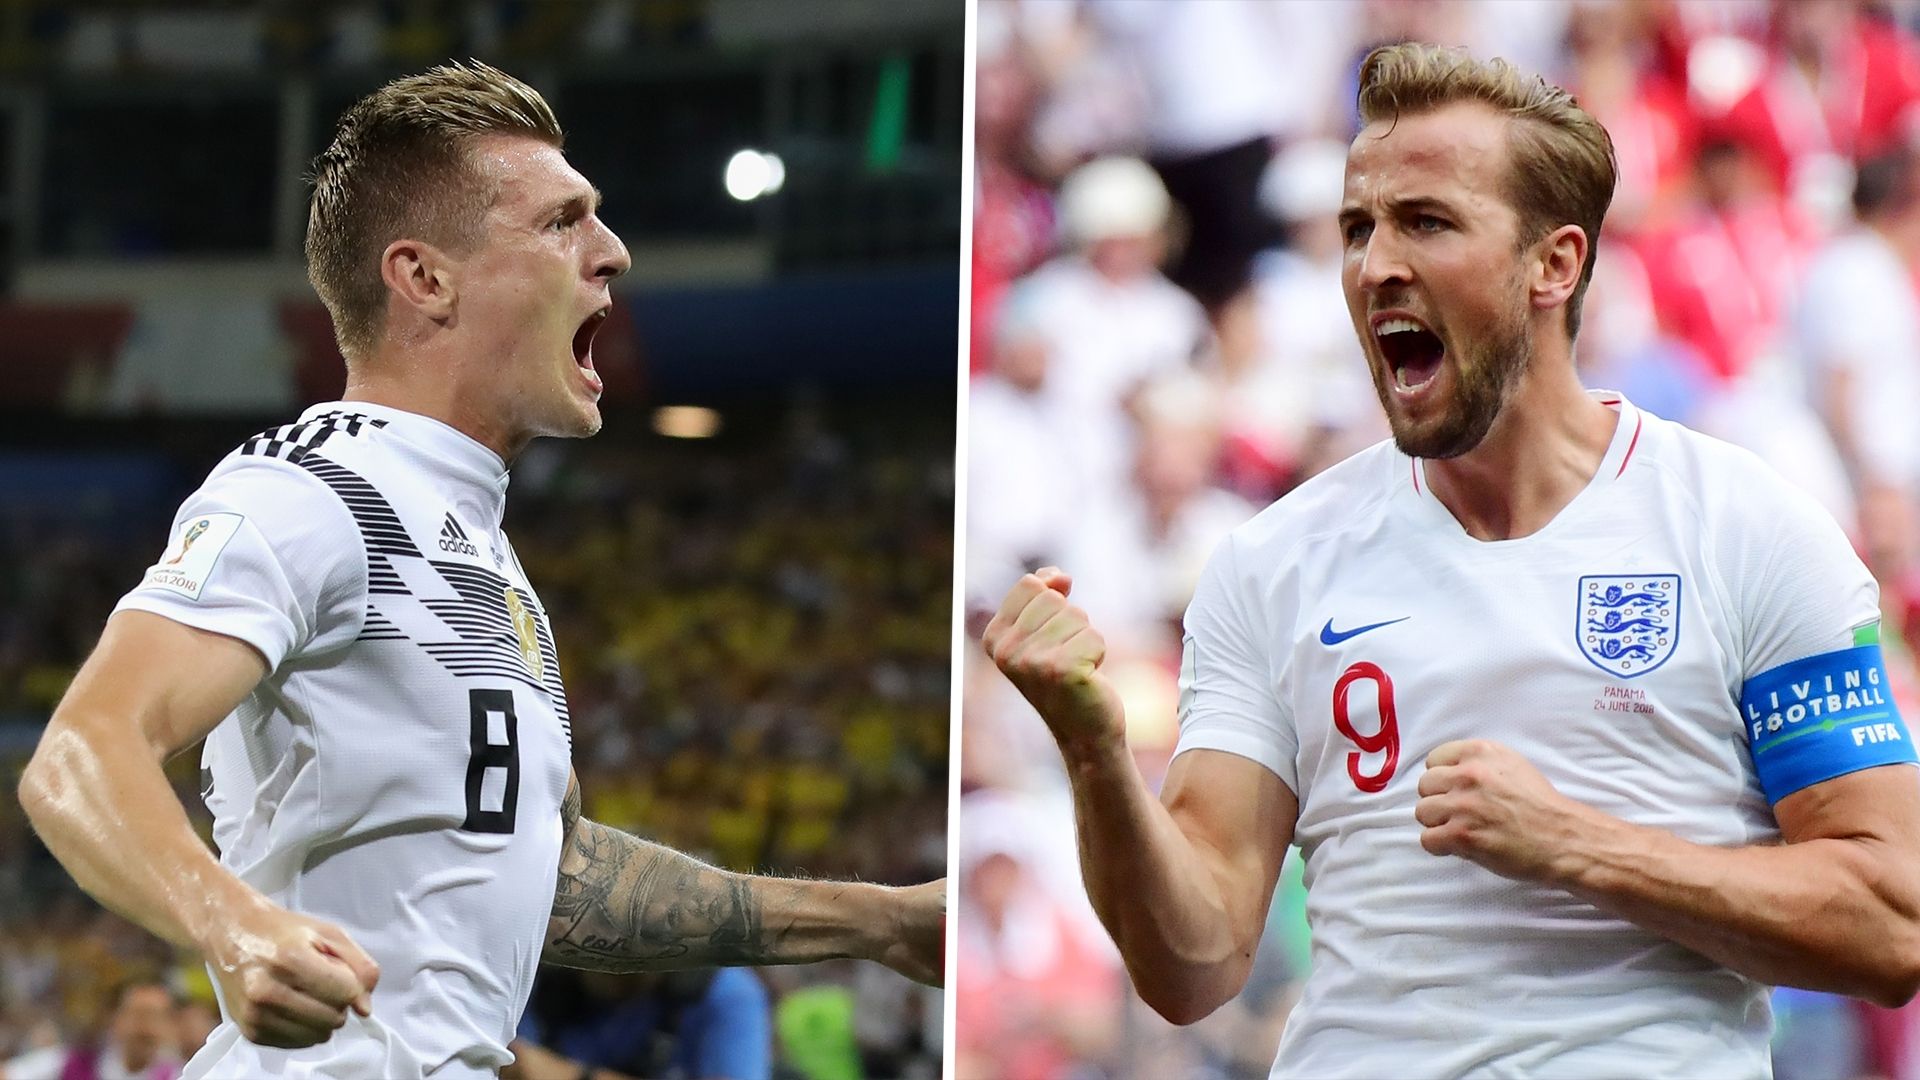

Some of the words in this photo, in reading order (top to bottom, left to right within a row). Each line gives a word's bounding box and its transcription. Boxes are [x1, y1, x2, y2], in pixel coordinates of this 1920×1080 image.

[438, 536, 480, 558] adidas
[169, 575, 197, 592] 2018
[1593, 699, 1606, 711] 24
[1608, 700, 1631, 713] JUNE
[1633, 702, 1655, 714] 2018
[1603, 686, 1646, 700] PANAMA
[1748, 667, 1880, 721] LIVING
[1333, 661, 1400, 793] 9
[1752, 687, 1885, 741] FOOTBALL
[1851, 723, 1901, 746] FIFA
[461, 688, 520, 834] 8
[552, 899, 632, 955] Leon
